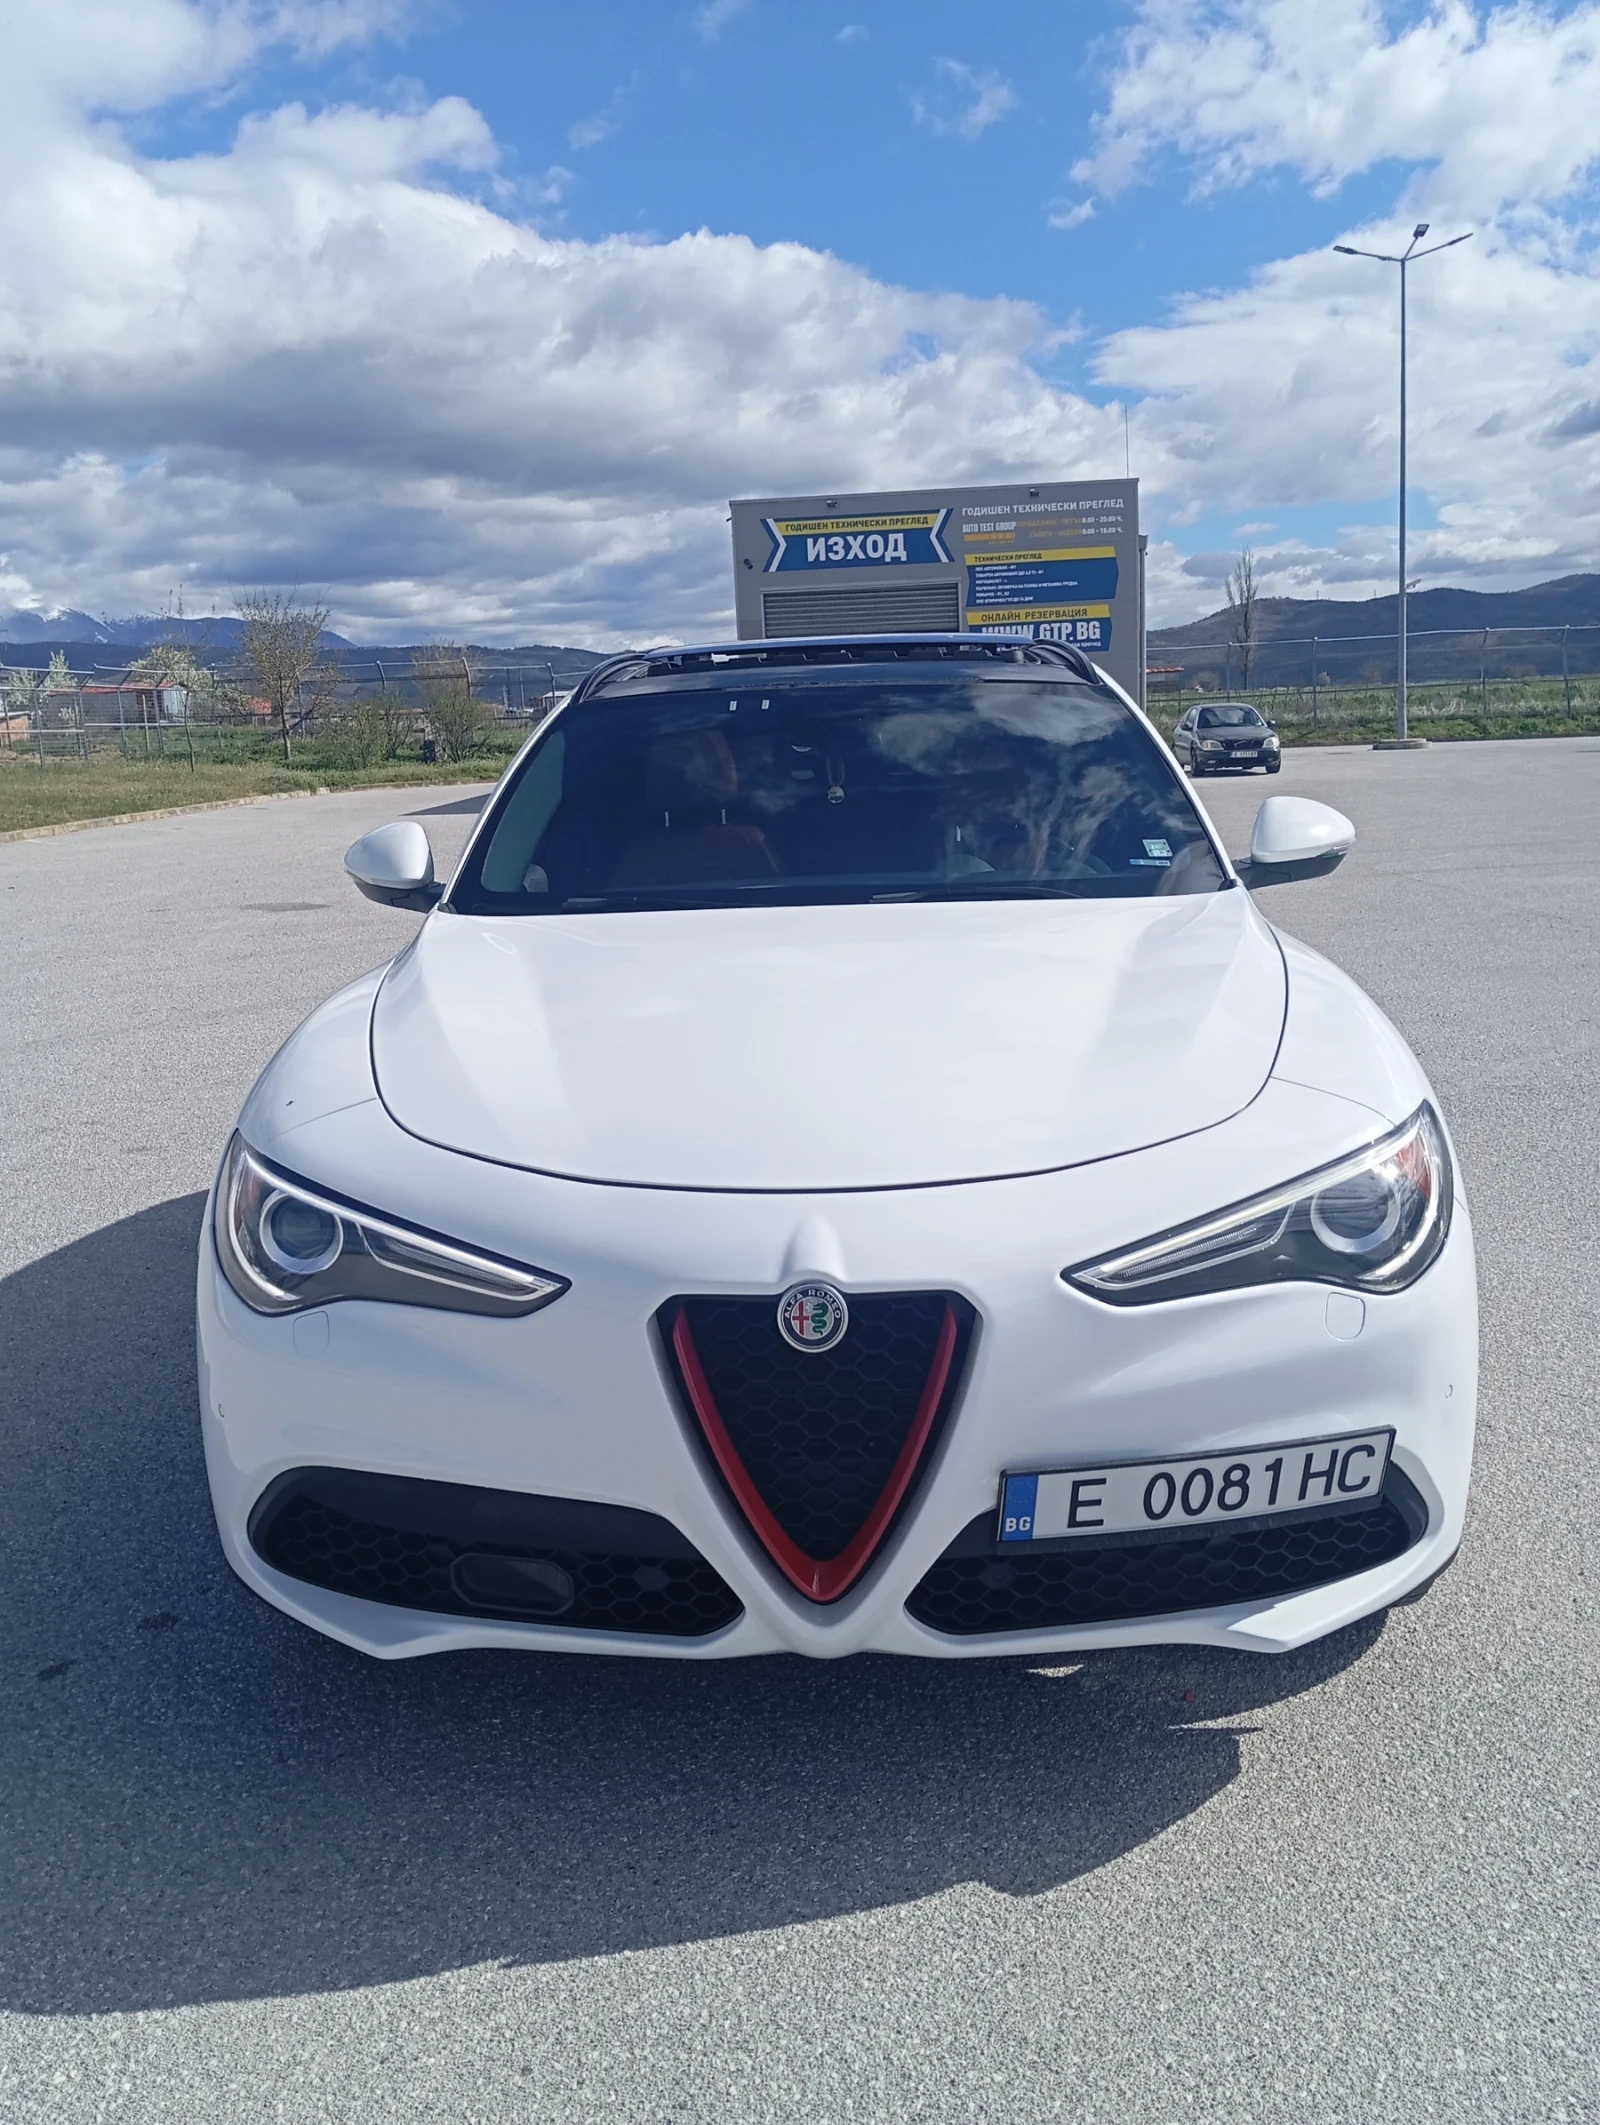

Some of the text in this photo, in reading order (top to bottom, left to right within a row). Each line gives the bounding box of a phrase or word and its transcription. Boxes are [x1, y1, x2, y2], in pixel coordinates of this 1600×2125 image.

[962, 498, 1124, 517] ГОДИШЕН ТЕХНИЧЕСКИ ПРЕГЛЕД
[785, 516, 929, 532] ГОДИШЕН ТЕХНИЧЕСКИ ПРЕГЛЕД
[962, 521, 1016, 533] AUTO TEST GROUP
[807, 533, 907, 562] ИЗХОД
[974, 553, 1042, 563] ТЕХНИЧЕСКИ ПРЕГЛЕД
[981, 608, 1088, 623] ОНЛАЙН РЕЗЕРВАЦИЯ
[982, 621, 1101, 641] WGTP.BG
[784, 1289, 841, 1319] ALFA ROMEO
[1067, 1478, 1107, 1529] E
[1005, 1516, 1031, 1532] BG
